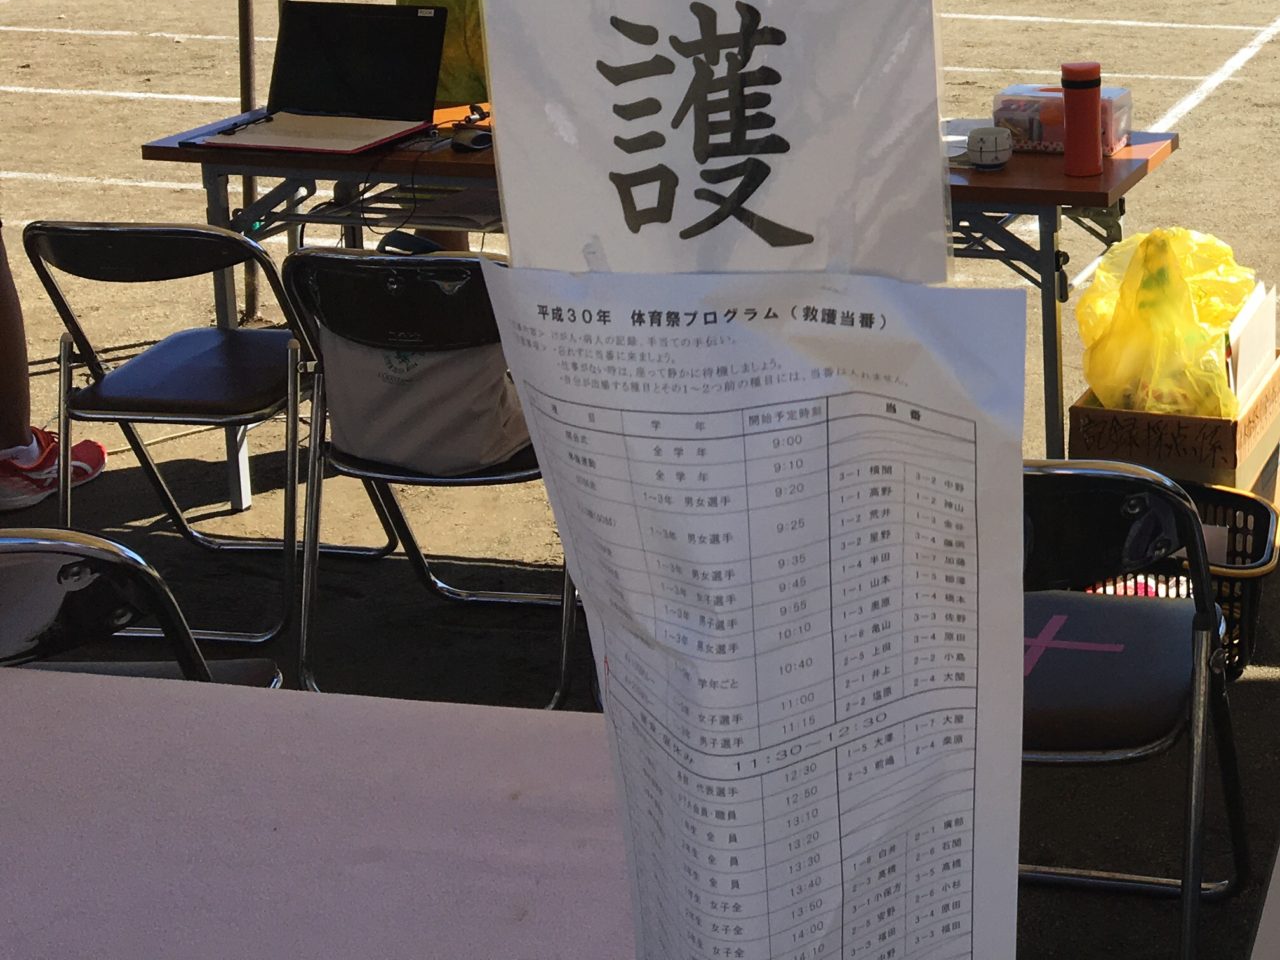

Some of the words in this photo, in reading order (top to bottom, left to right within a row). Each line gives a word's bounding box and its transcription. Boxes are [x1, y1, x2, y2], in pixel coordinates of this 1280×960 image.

[537, 304, 612, 326] 平成30年
[748, 406, 823, 428] 開始予定時刻
[772, 434, 803, 449] 9:00
[773, 458, 804, 475] 9:10
[775, 482, 805, 499] 9:20
[776, 517, 806, 535] 9:25
[777, 552, 807, 570] 9:35
[778, 575, 807, 593] 9:45
[778, 622, 812, 641] 10:10
[779, 656, 813, 676] 10:40
[781, 691, 815, 711] 11:00
[781, 714, 816, 735] 11:15
